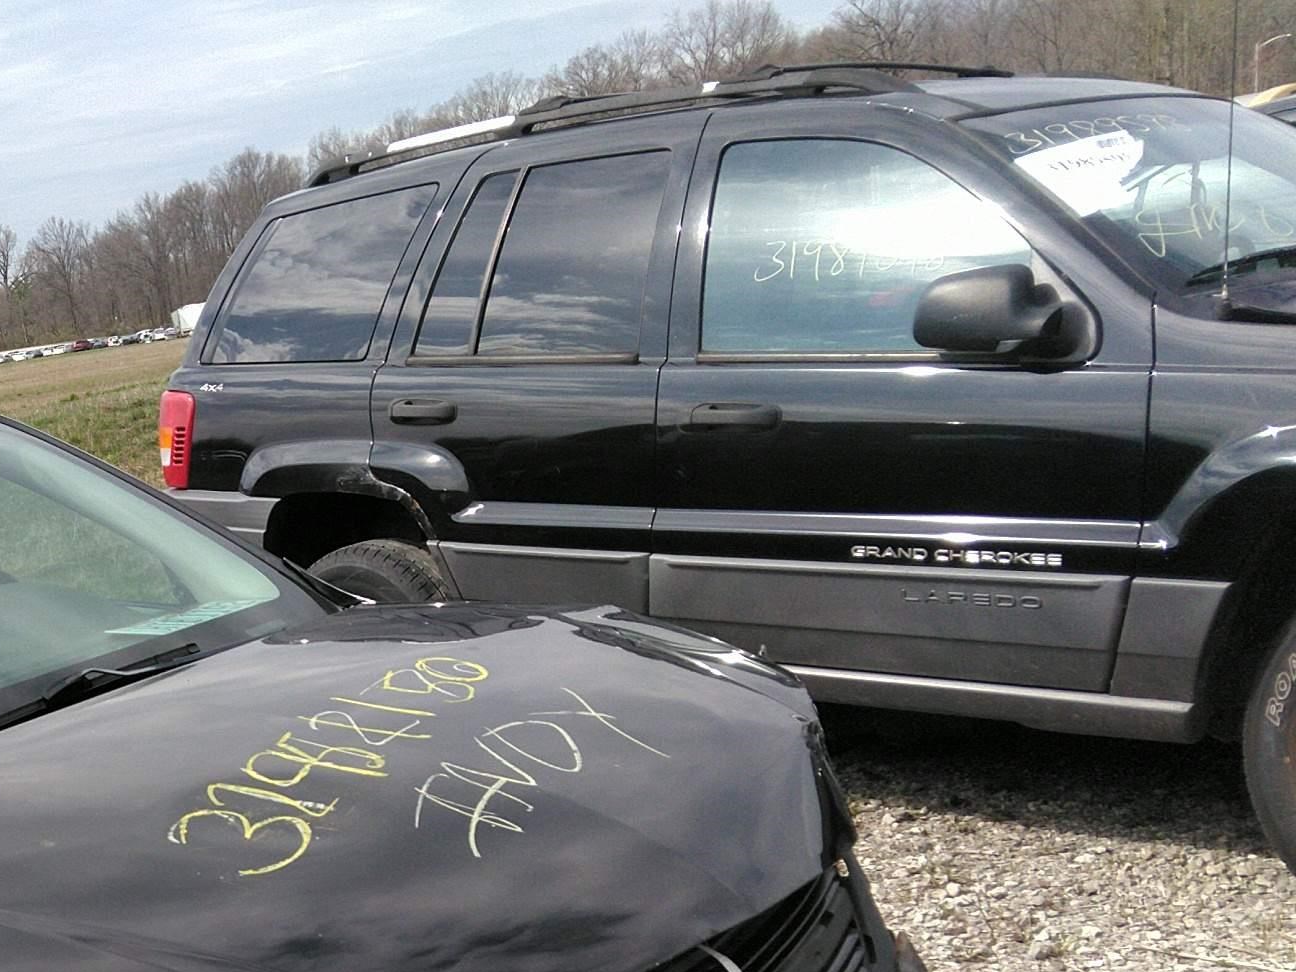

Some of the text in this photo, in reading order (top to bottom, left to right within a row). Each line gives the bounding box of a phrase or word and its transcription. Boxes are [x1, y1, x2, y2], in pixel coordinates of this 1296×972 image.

[850, 545, 1063, 567] GRAND CHEROKEE
[901, 587, 1043, 609] LAREDO
